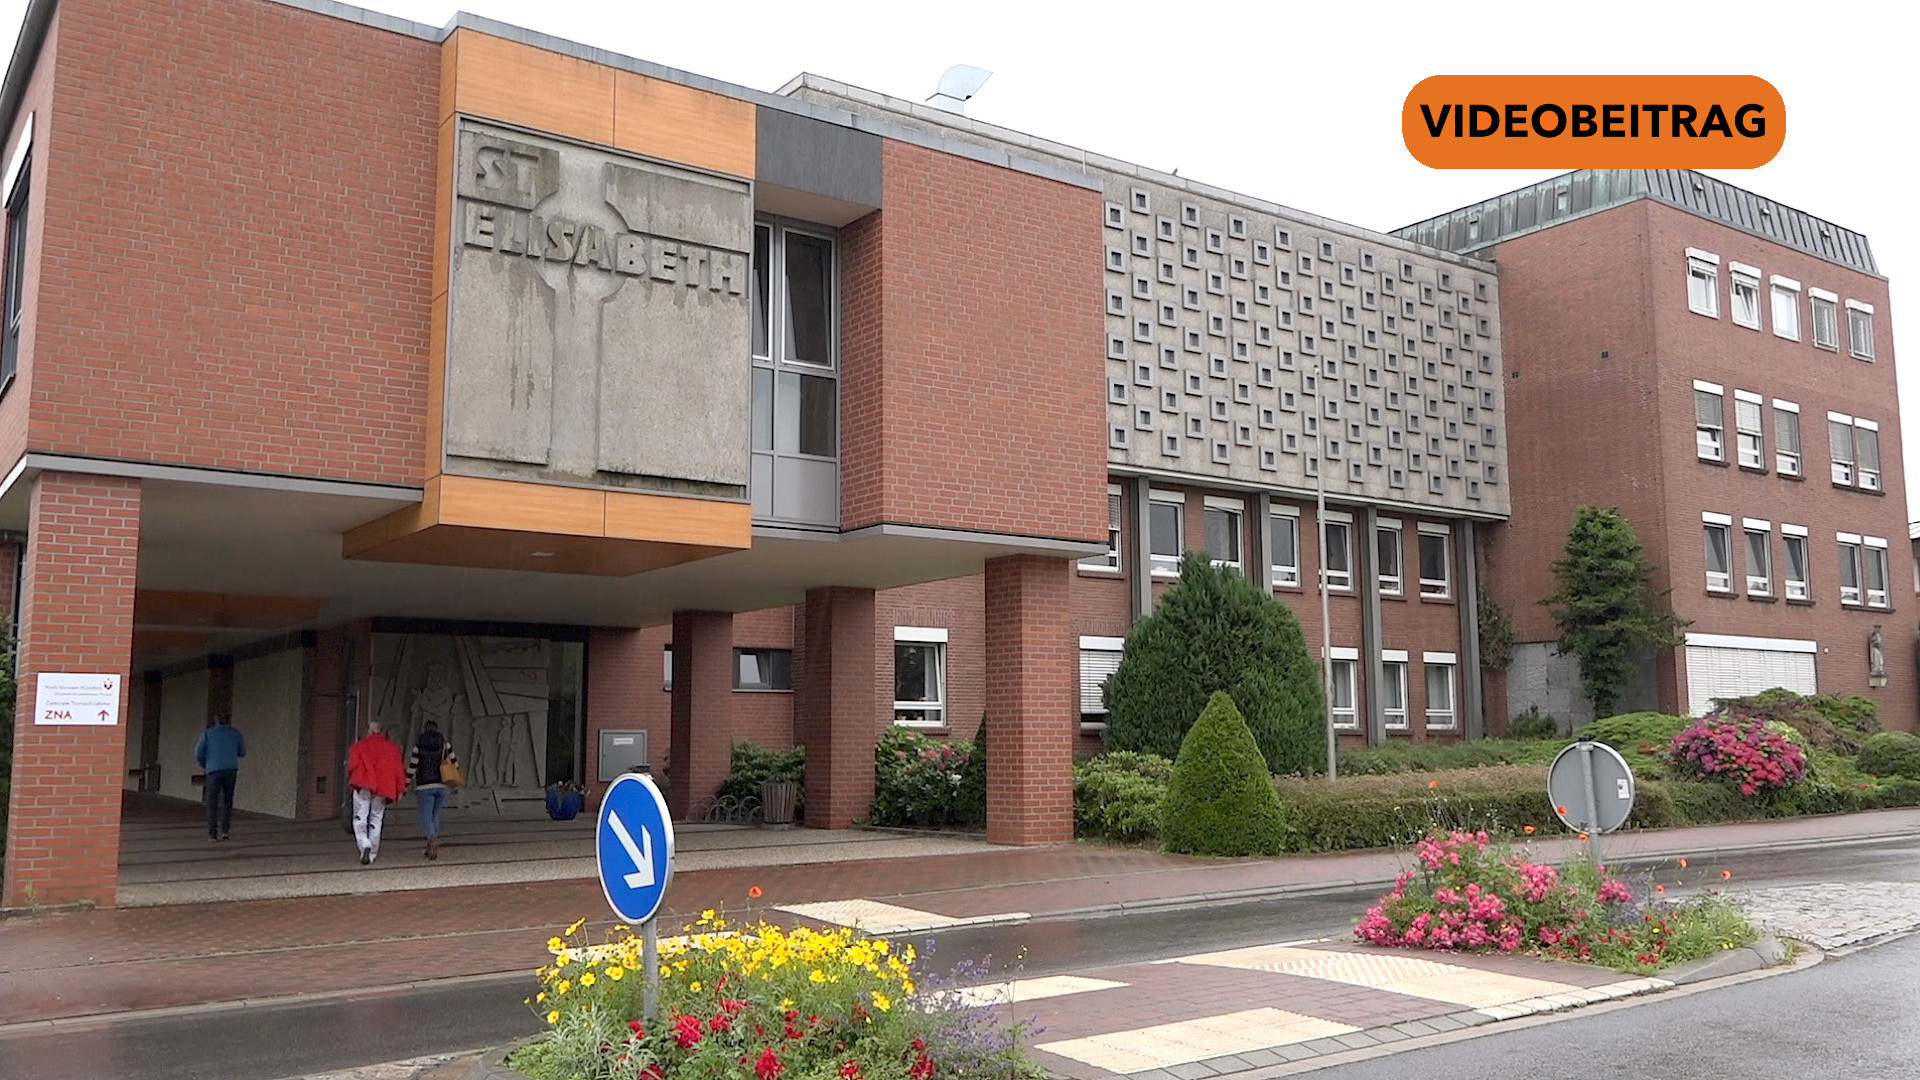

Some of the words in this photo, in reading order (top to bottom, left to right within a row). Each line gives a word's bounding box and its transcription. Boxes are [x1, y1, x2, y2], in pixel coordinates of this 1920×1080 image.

[476, 146, 539, 196] ST
[464, 202, 743, 295] ELISABETH
[44, 710, 72, 720] ZNA
